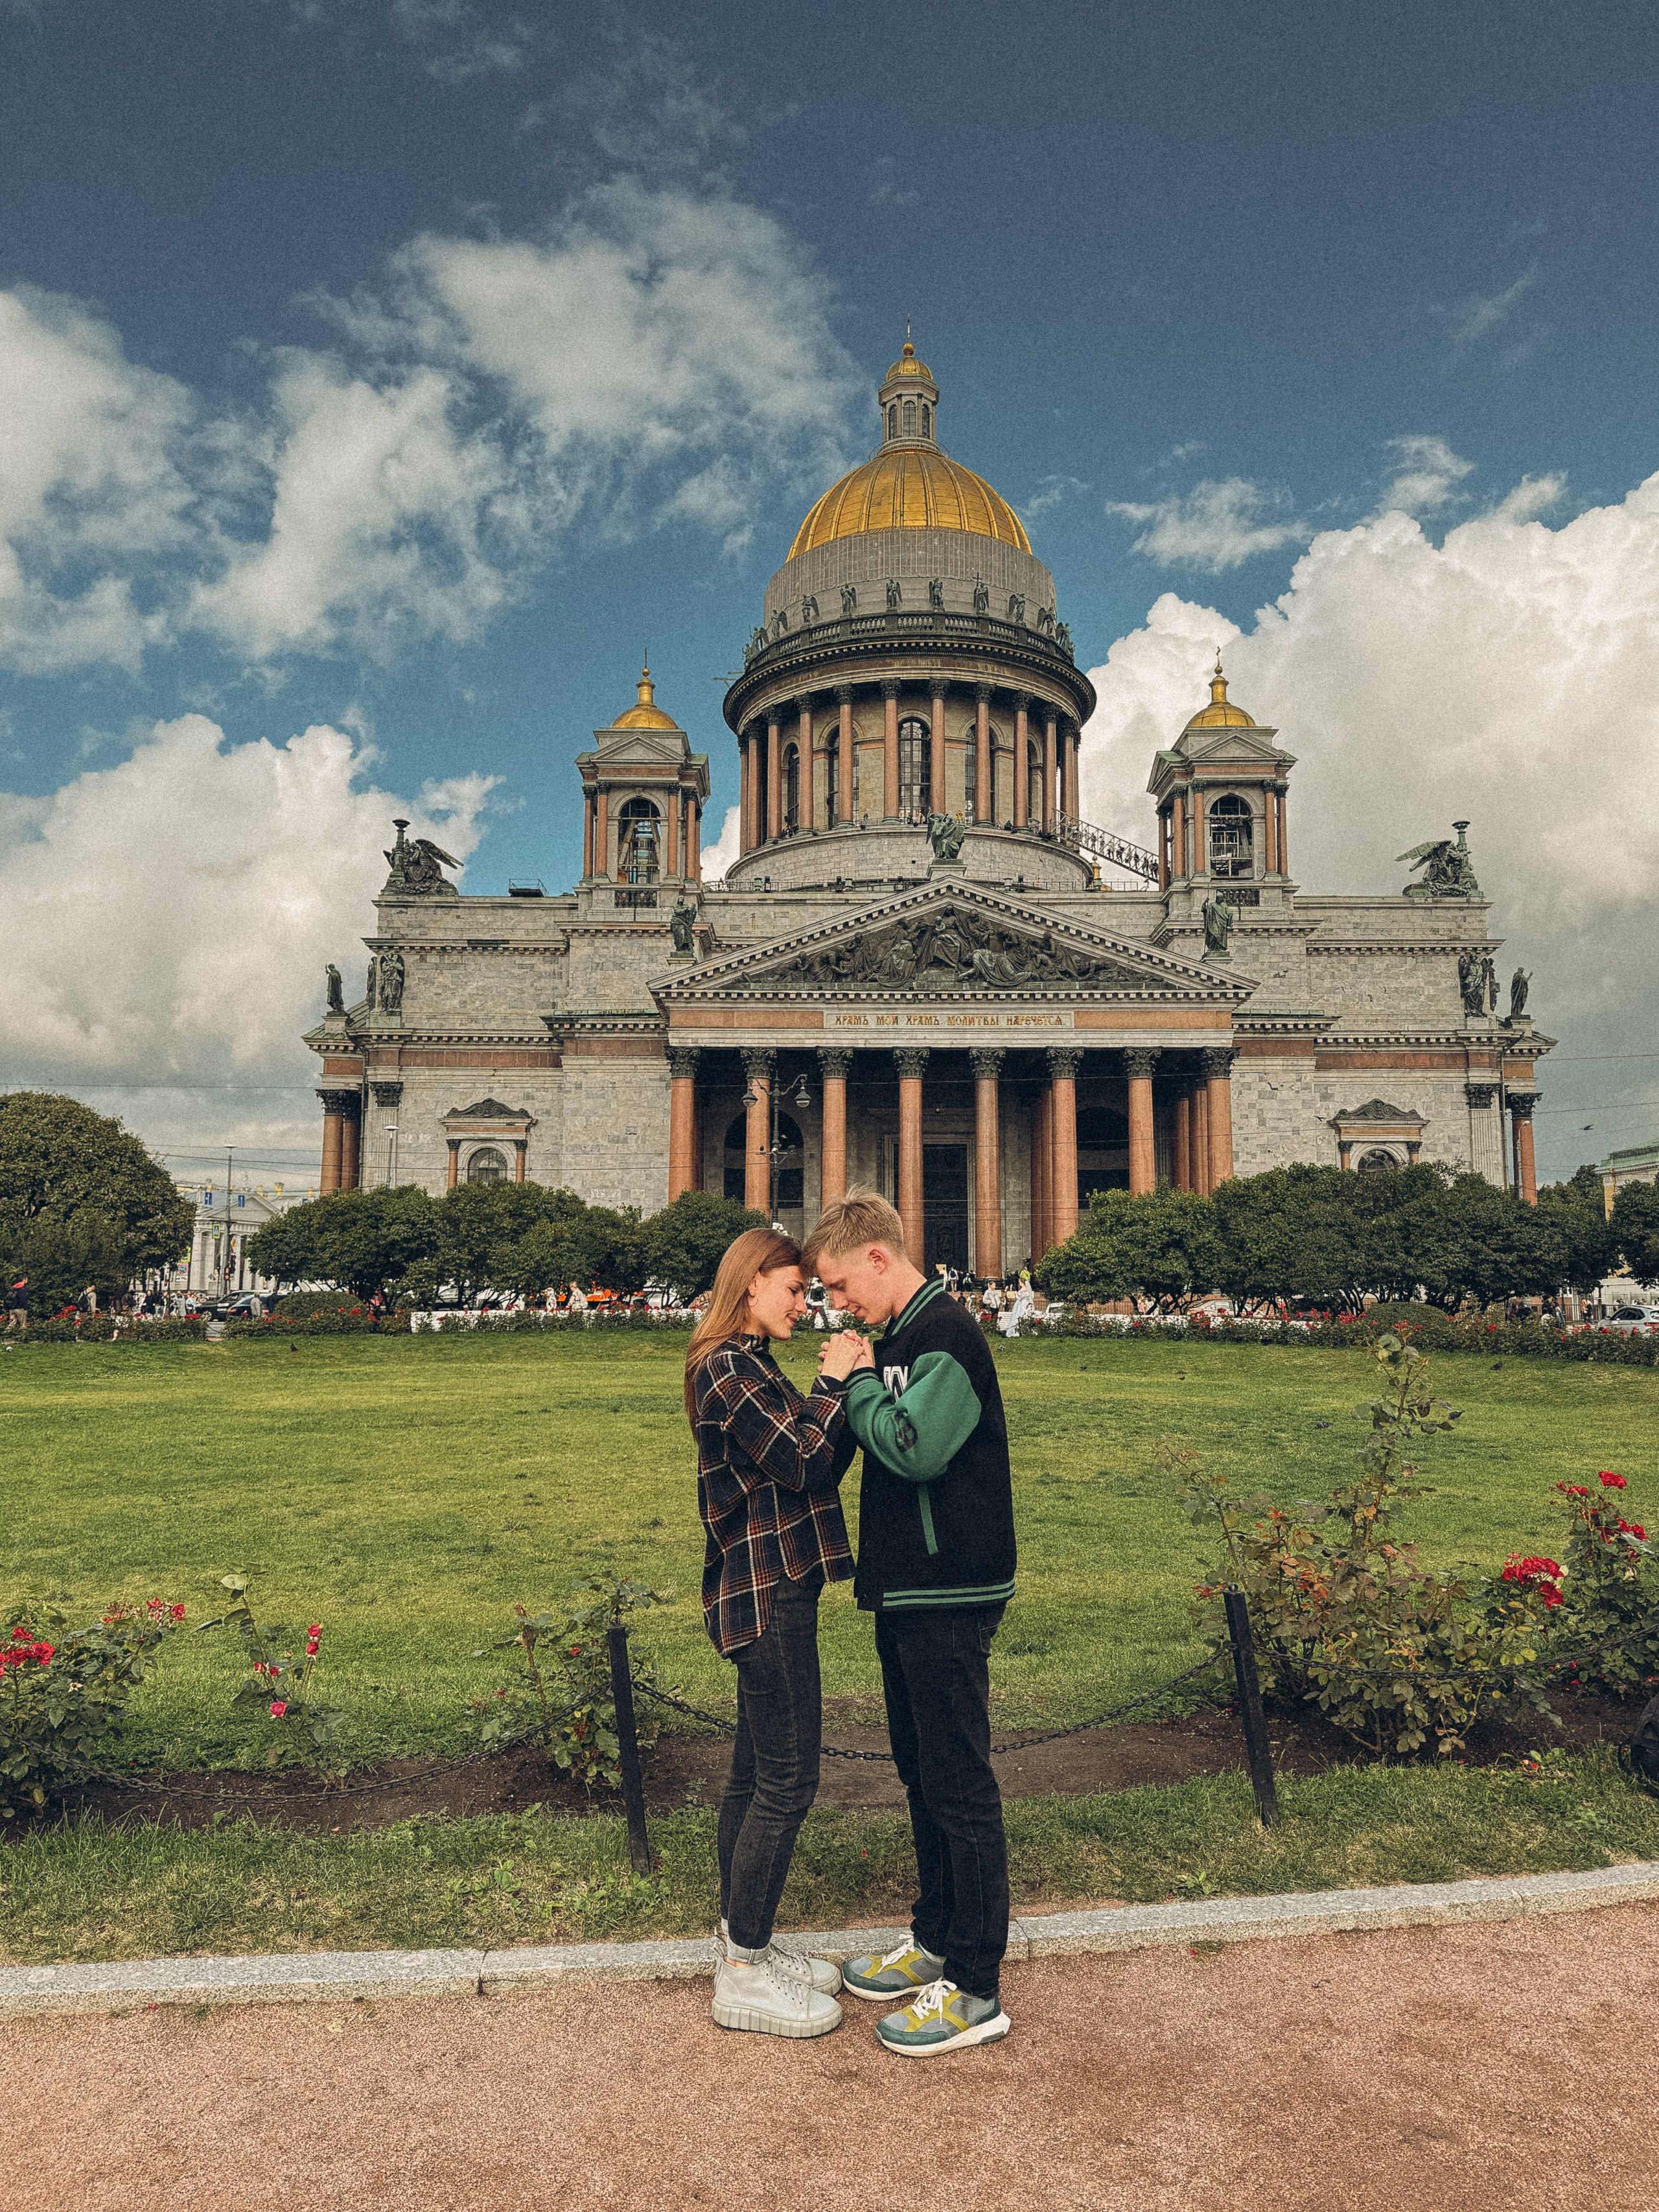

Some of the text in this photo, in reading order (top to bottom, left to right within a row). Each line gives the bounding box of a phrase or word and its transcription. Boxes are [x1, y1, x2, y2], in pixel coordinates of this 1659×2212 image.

[835, 1015, 869, 1025] ХРАМЪ
[906, 1015, 940, 1025] ХРАМЪ
[946, 1015, 999, 1026] МОЛИТВЫ
